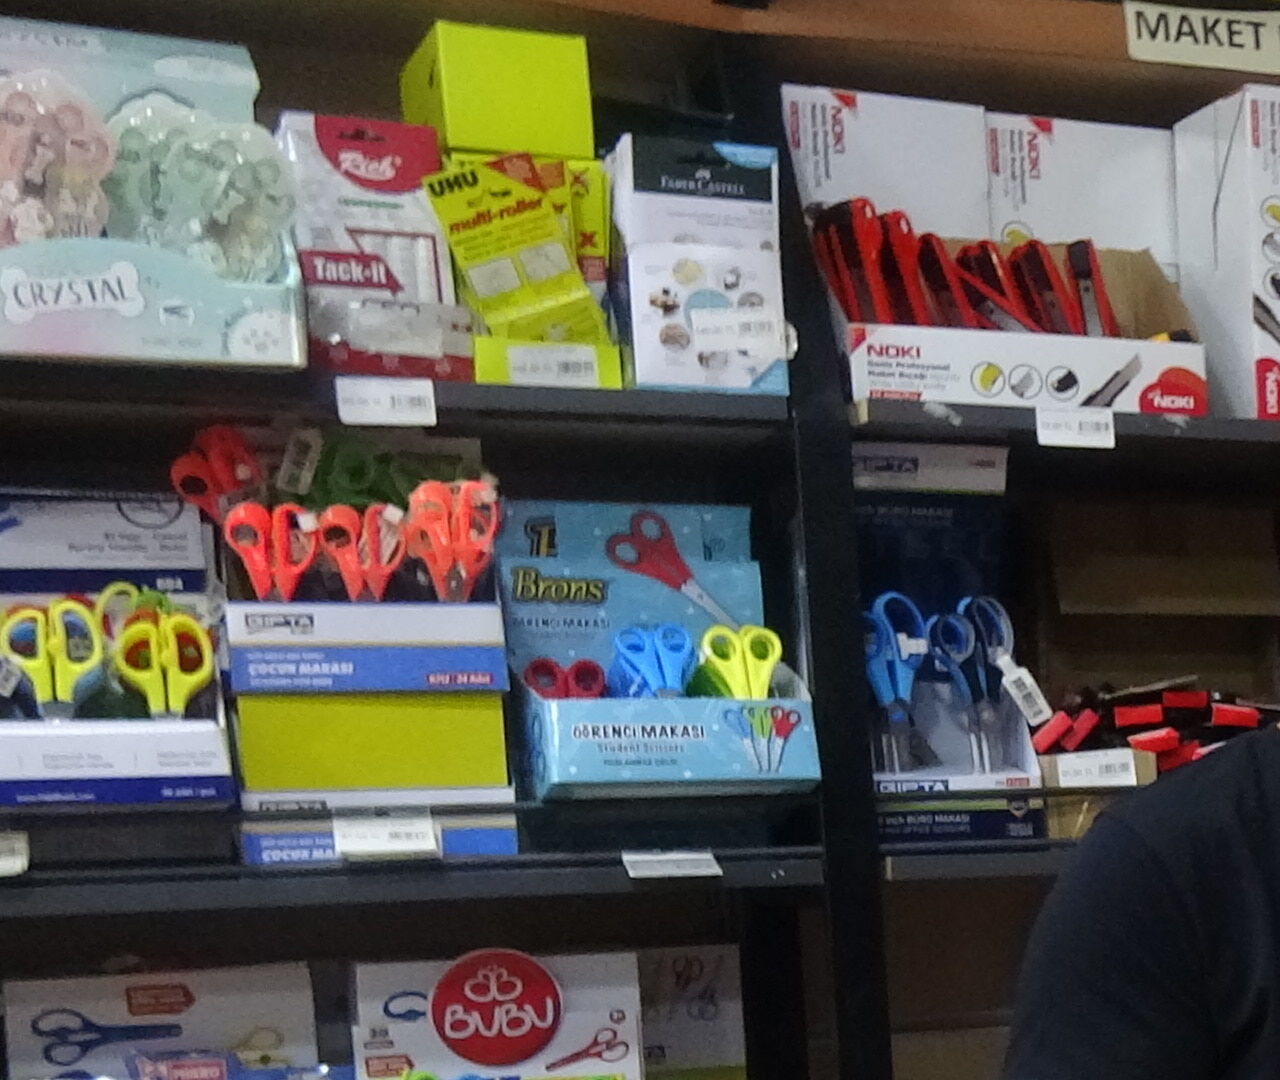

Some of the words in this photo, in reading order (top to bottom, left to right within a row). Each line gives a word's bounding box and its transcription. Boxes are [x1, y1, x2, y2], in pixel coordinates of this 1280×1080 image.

[1134, 9, 1264, 52] MAKET
[831, 105, 845, 154] NOKI
[337, 149, 396, 182] Rich
[1027, 131, 1041, 180] NOKI
[428, 169, 480, 199] UHU
[13, 278, 137, 309] CRYSTAL
[866, 344, 922, 359] NOKI
[1153, 393, 1196, 411] NOKI
[511, 565, 607, 602] Brons
[640, 723, 705, 739] MAKASI
[444, 996, 555, 1040] BUBU
